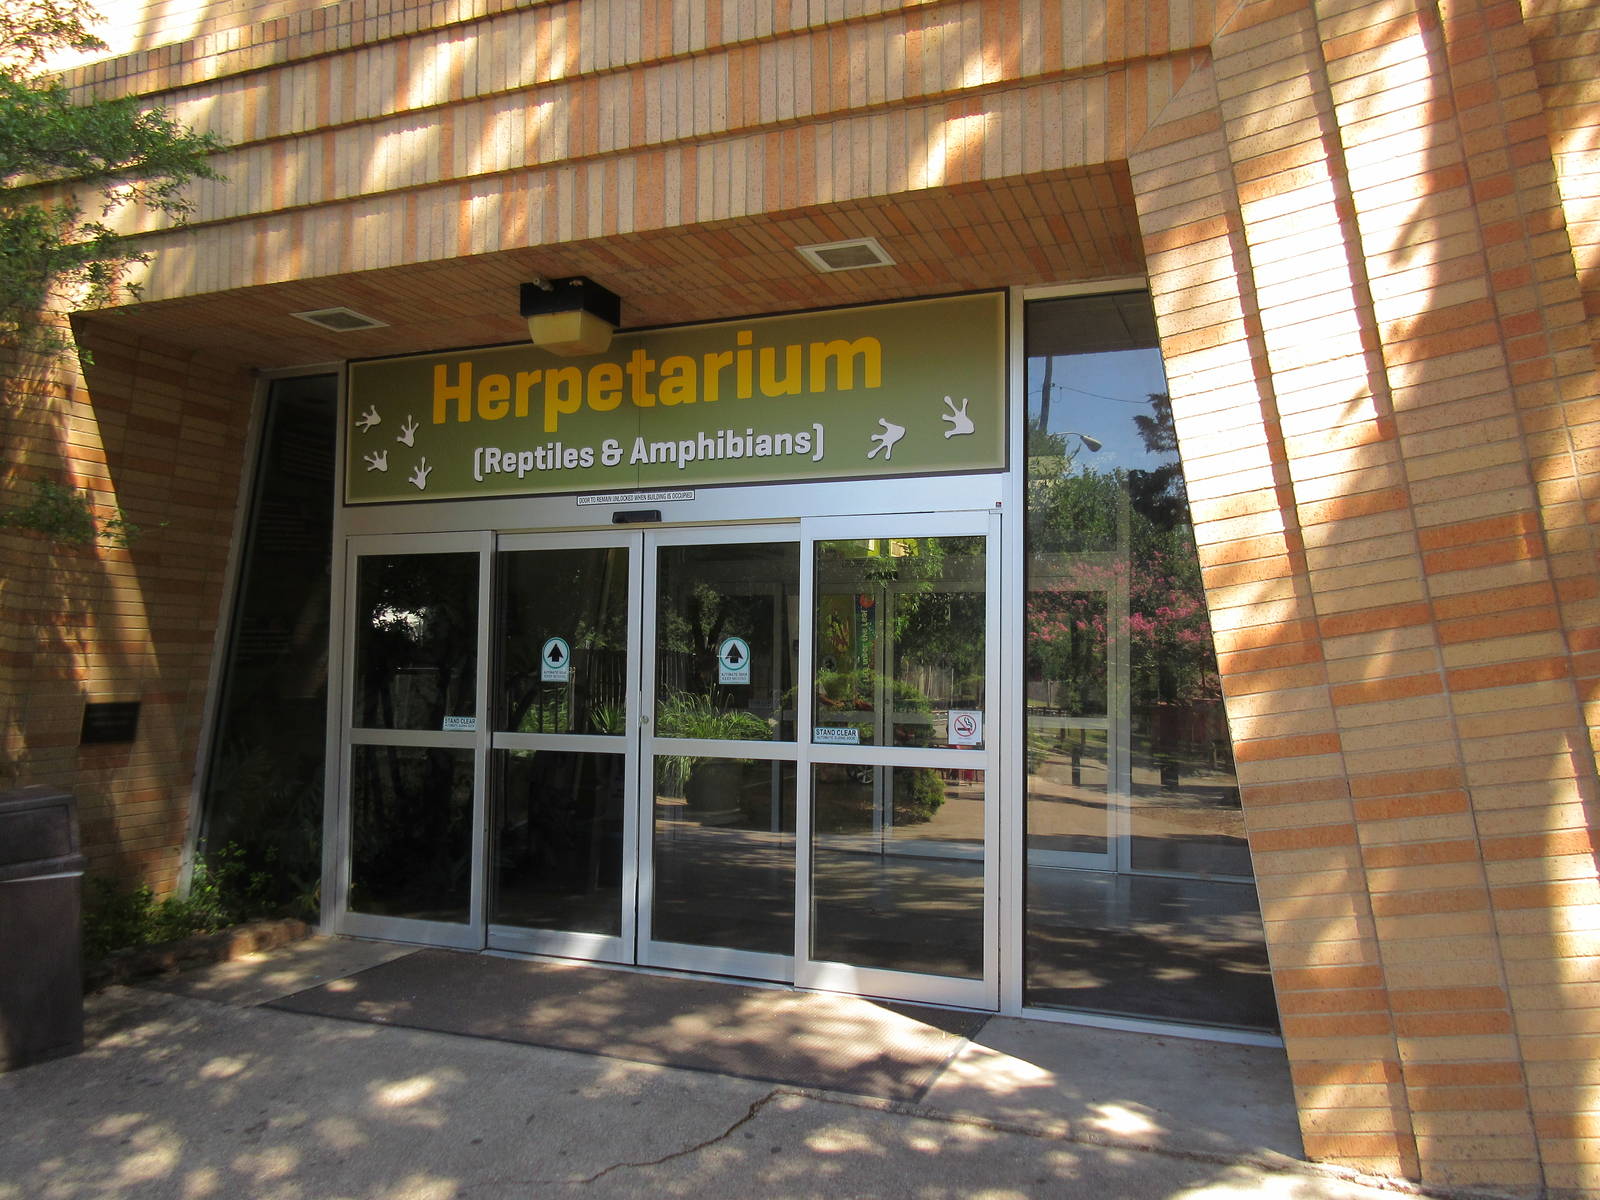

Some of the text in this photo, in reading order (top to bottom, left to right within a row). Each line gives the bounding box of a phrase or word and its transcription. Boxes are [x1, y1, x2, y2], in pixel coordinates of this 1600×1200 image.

[433, 330, 883, 433] Herpetarium
[601, 439, 624, 467] &
[578, 496, 591, 504] DOOR
[596, 495, 612, 503] REMAIN
[612, 494, 634, 502] UNLOCKED
[634, 493, 647, 501] WHEN
[647, 492, 666, 501] BUILDING
[672, 491, 693, 500] OCCUPIED
[815, 728, 857, 737] STAND CLEAR
